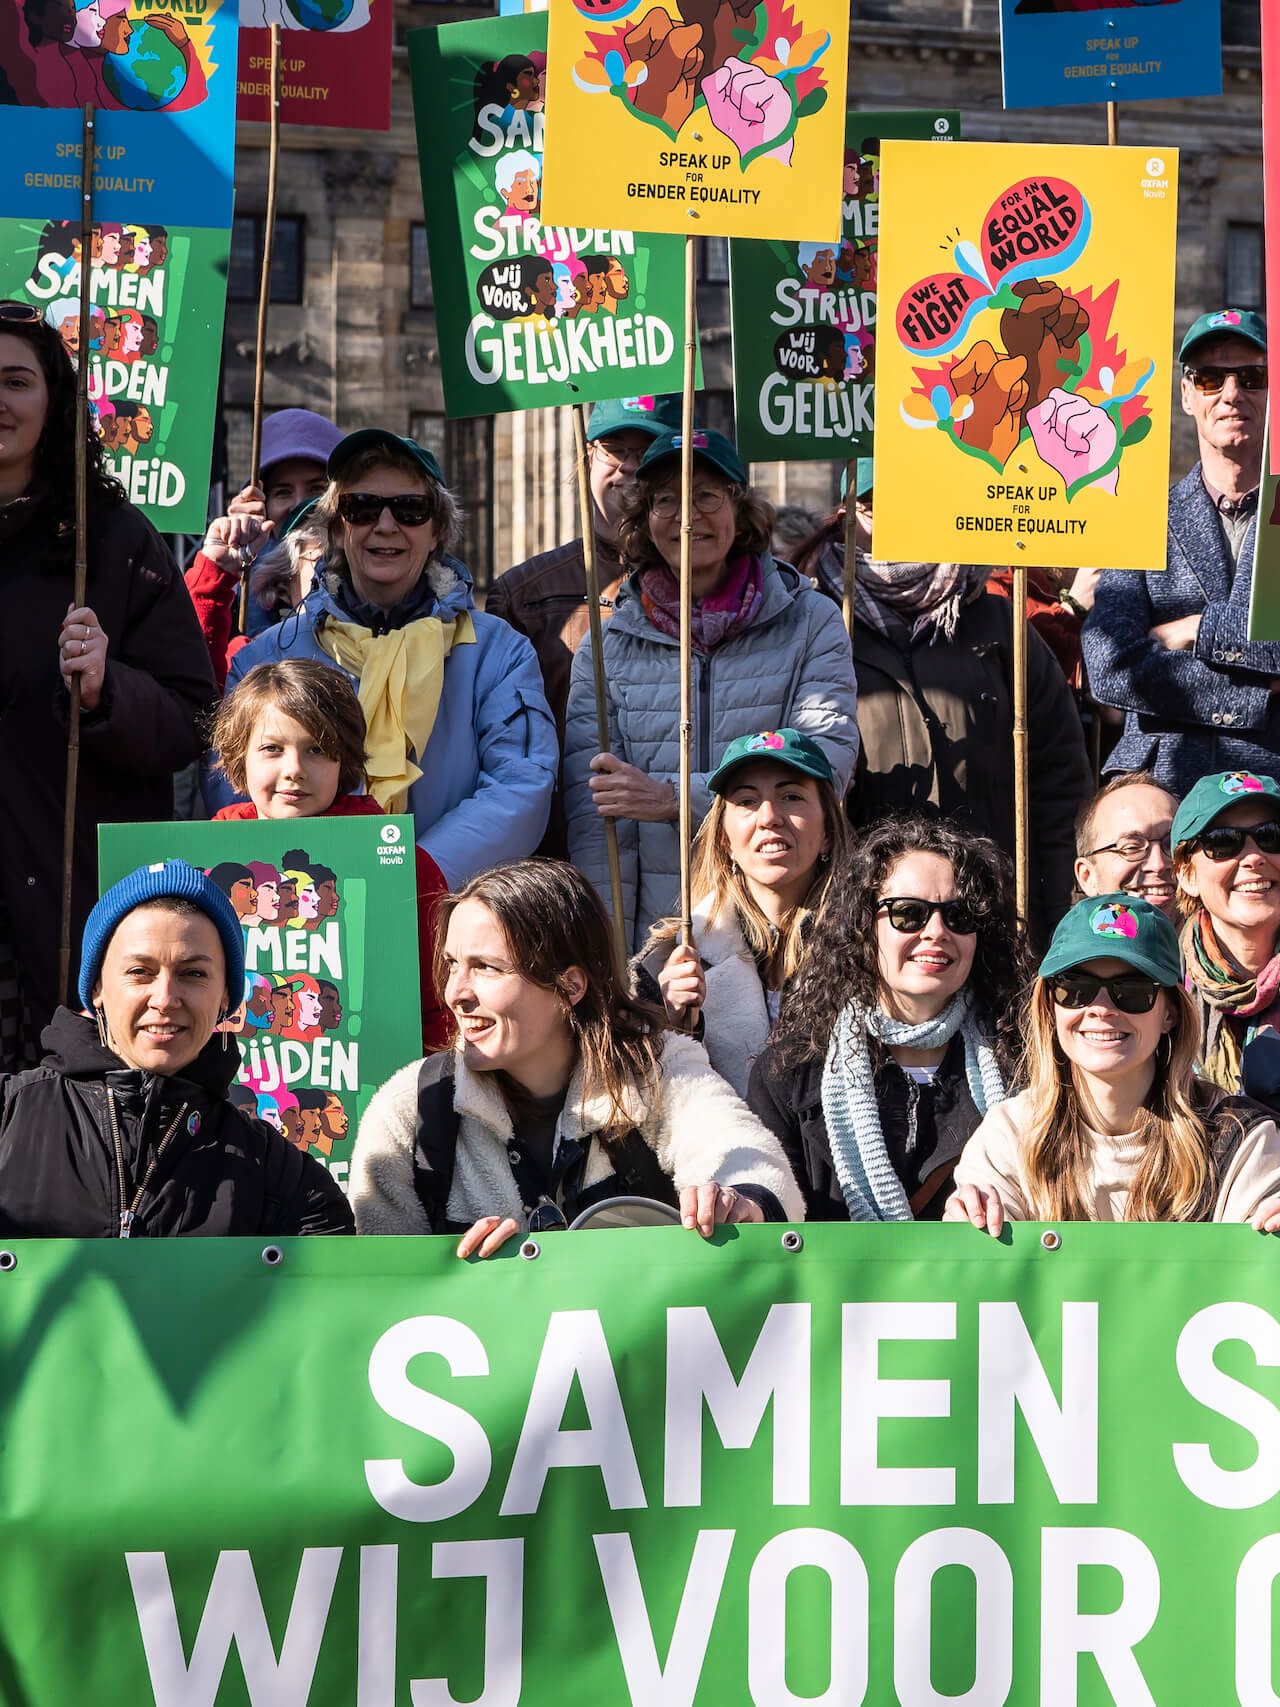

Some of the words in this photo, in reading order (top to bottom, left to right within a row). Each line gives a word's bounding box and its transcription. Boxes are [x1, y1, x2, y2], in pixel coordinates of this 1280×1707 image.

[1086, 38, 1120, 51] SPEAK
[1124, 37, 1139, 49] UP
[249, 56, 286, 71] SPEK
[290, 60, 306, 72] UP
[1064, 65, 1107, 78] GENDER
[1110, 61, 1162, 76] EQUALITY
[281, 86, 329, 100] QUALITY
[56, 143, 102, 160] SPEK
[107, 146, 126, 160] UP
[659, 152, 707, 169] SPEAK
[712, 155, 731, 170] UP
[25, 173, 81, 189] GENDER
[95, 179, 155, 193] QUALITY
[686, 172, 703, 183] FOR
[627, 183, 685, 200] GENDER
[690, 187, 761, 205] EQUALITY
[1001, 192, 1022, 211] FOR
[1023, 182, 1040, 198] AN
[988, 182, 1069, 246] EQUAL
[990, 205, 1077, 271] WORLD
[482, 285, 528, 312] VOOR
[912, 283, 938, 305] WE
[780, 347, 820, 375] VOOR
[987, 485, 1034, 500] SPEAK
[1038, 487, 1057, 501] UP
[1012, 505, 1030, 514] FOR
[956, 517, 1013, 532] GENDER
[1017, 519, 1087, 535] EQUALITY
[377, 846, 405, 855] OXFAM
[380, 856, 403, 864] Novib
[245, 922, 343, 980] MEN
[364, 1301, 1099, 1523] SAMEN
[124, 1537, 526, 1707] WIJ
[592, 1527, 1161, 1707] VOOR
